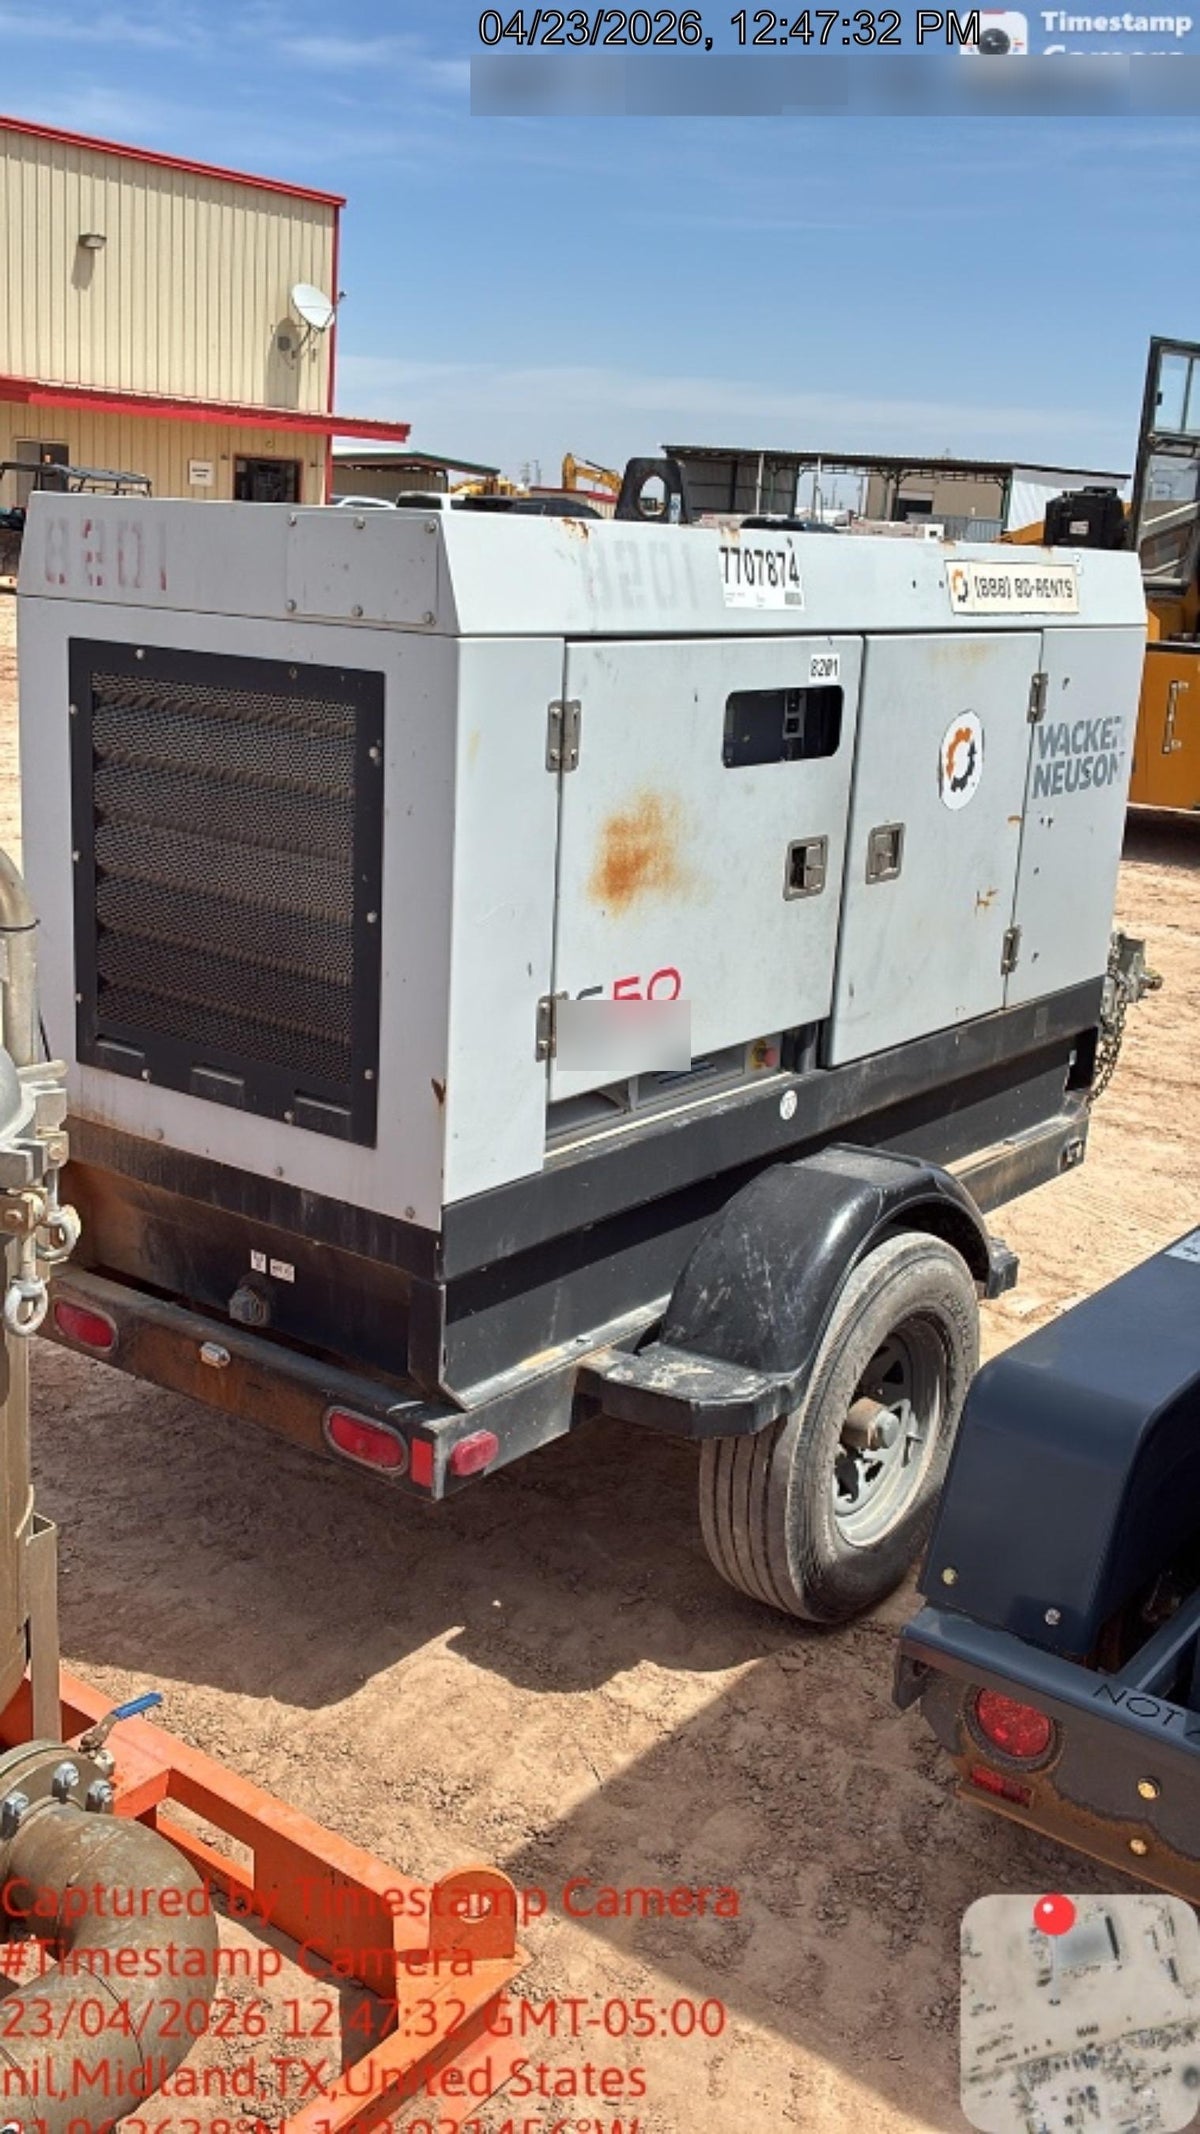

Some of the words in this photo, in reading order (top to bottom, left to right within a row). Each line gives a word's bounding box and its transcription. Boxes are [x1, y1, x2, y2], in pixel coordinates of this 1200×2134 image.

[719, 547, 801, 588] 7707874
[810, 658, 838, 677] 8201
[1092, 1683, 1184, 1727] NOT
